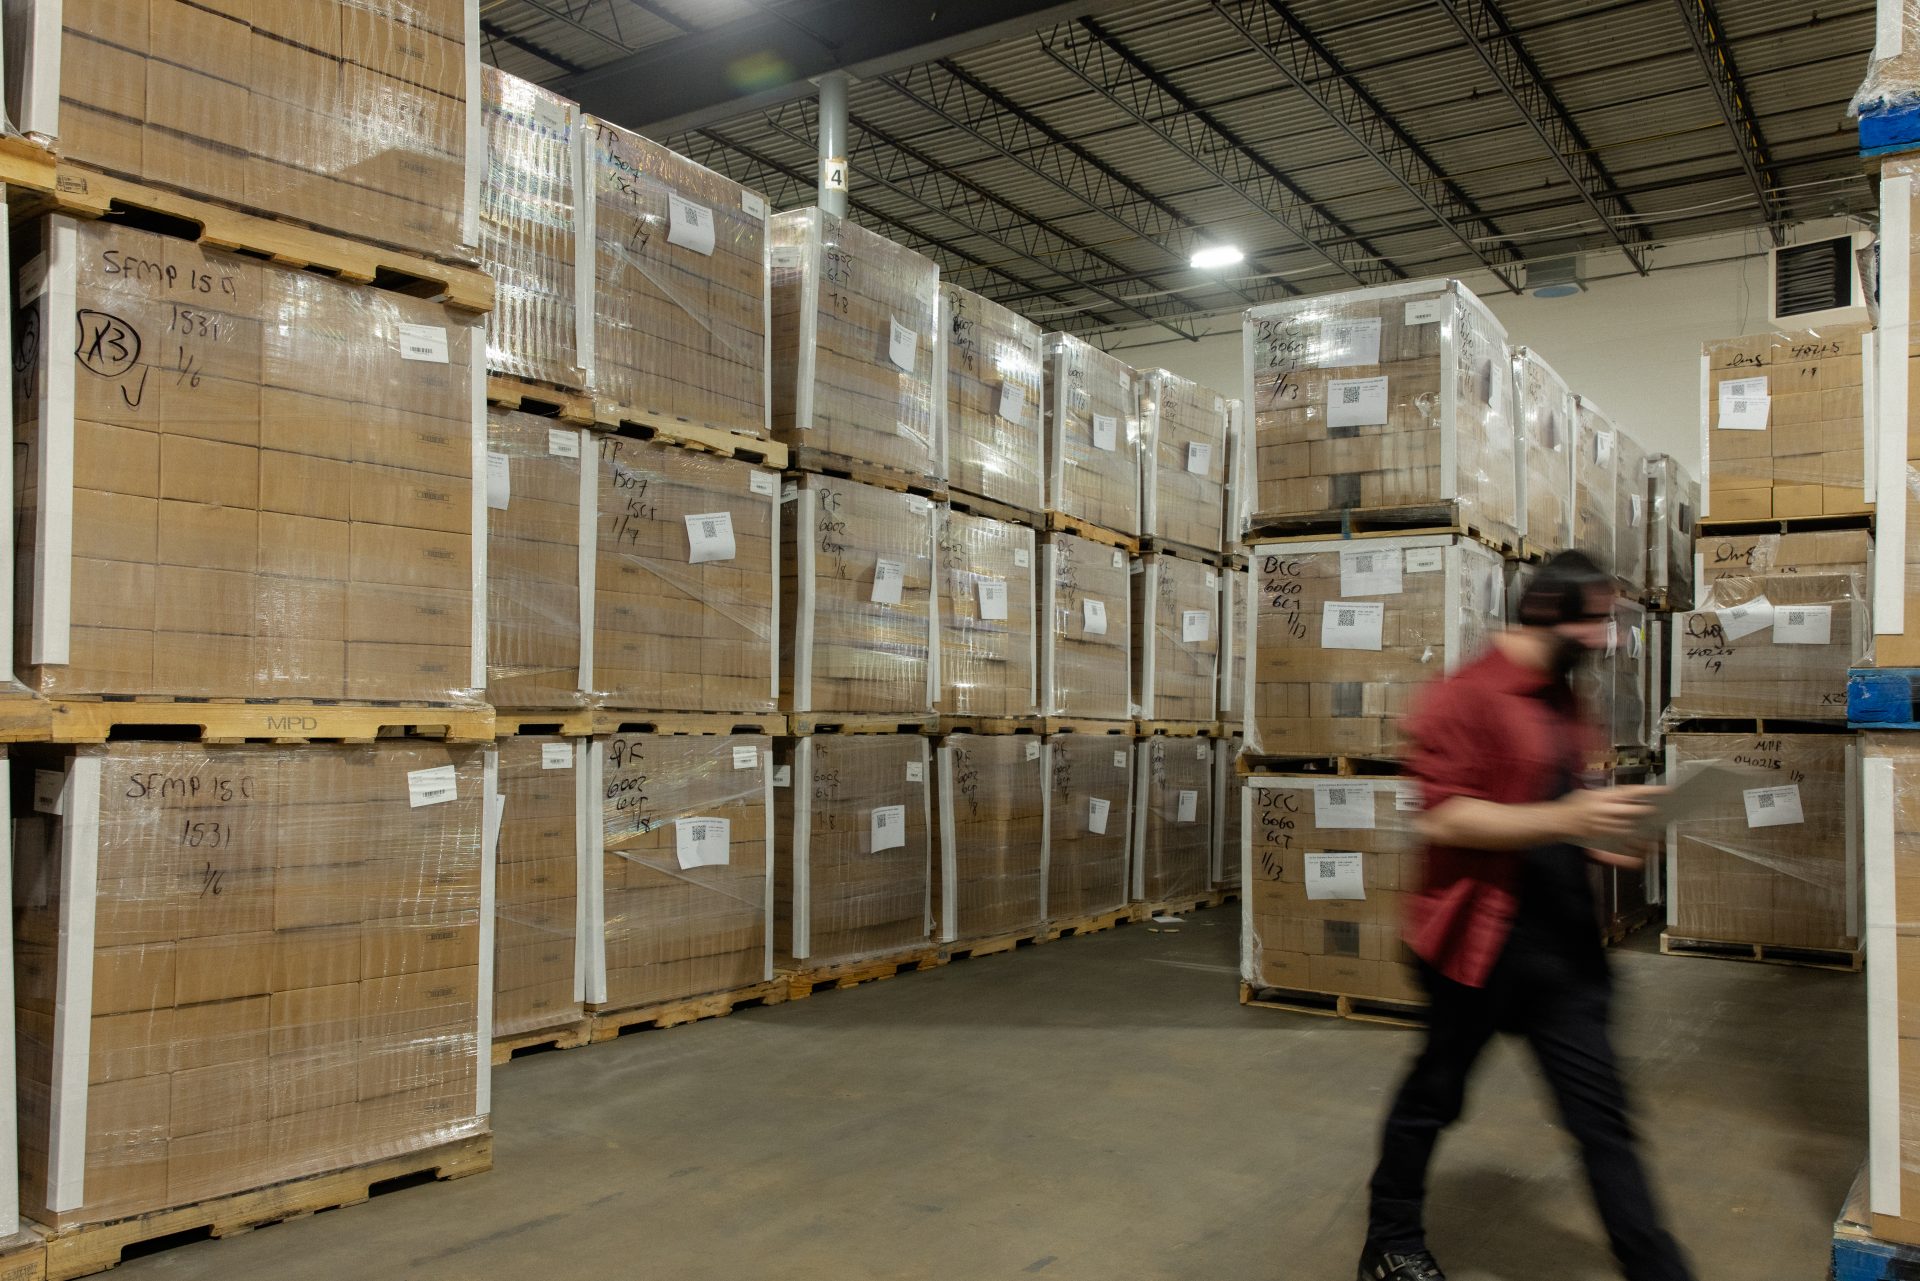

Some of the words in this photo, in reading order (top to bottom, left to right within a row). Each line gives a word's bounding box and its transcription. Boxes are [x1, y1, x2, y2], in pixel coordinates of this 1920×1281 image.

[831, 169, 842, 186] 4
[102, 250, 177, 289] SFMP
[170, 304, 218, 342] 1531
[1257, 318, 1300, 341] BCC
[1270, 338, 1304, 353] 6060
[175, 345, 201, 388] 1/6
[1269, 355, 1299, 370] 6CT
[1269, 373, 1300, 404] 1/13
[613, 468, 648, 497] 1507
[820, 488, 842, 512] PF
[819, 518, 846, 536] 6002
[1264, 556, 1301, 577] BCC
[1264, 578, 1302, 595] 6060
[1273, 594, 1301, 610] 6CT
[1287, 611, 1307, 640] 1/13
[267, 715, 317, 731] MPD
[1734, 754, 1782, 769] 040215
[126, 773, 200, 800] SFMP
[1258, 787, 1299, 813] BCC
[1262, 810, 1295, 830] 6060
[181, 820, 231, 849] 1531
[1267, 830, 1293, 850] 6CT
[1262, 851, 1283, 881] 1/13
[200, 861, 224, 899] 1/6
